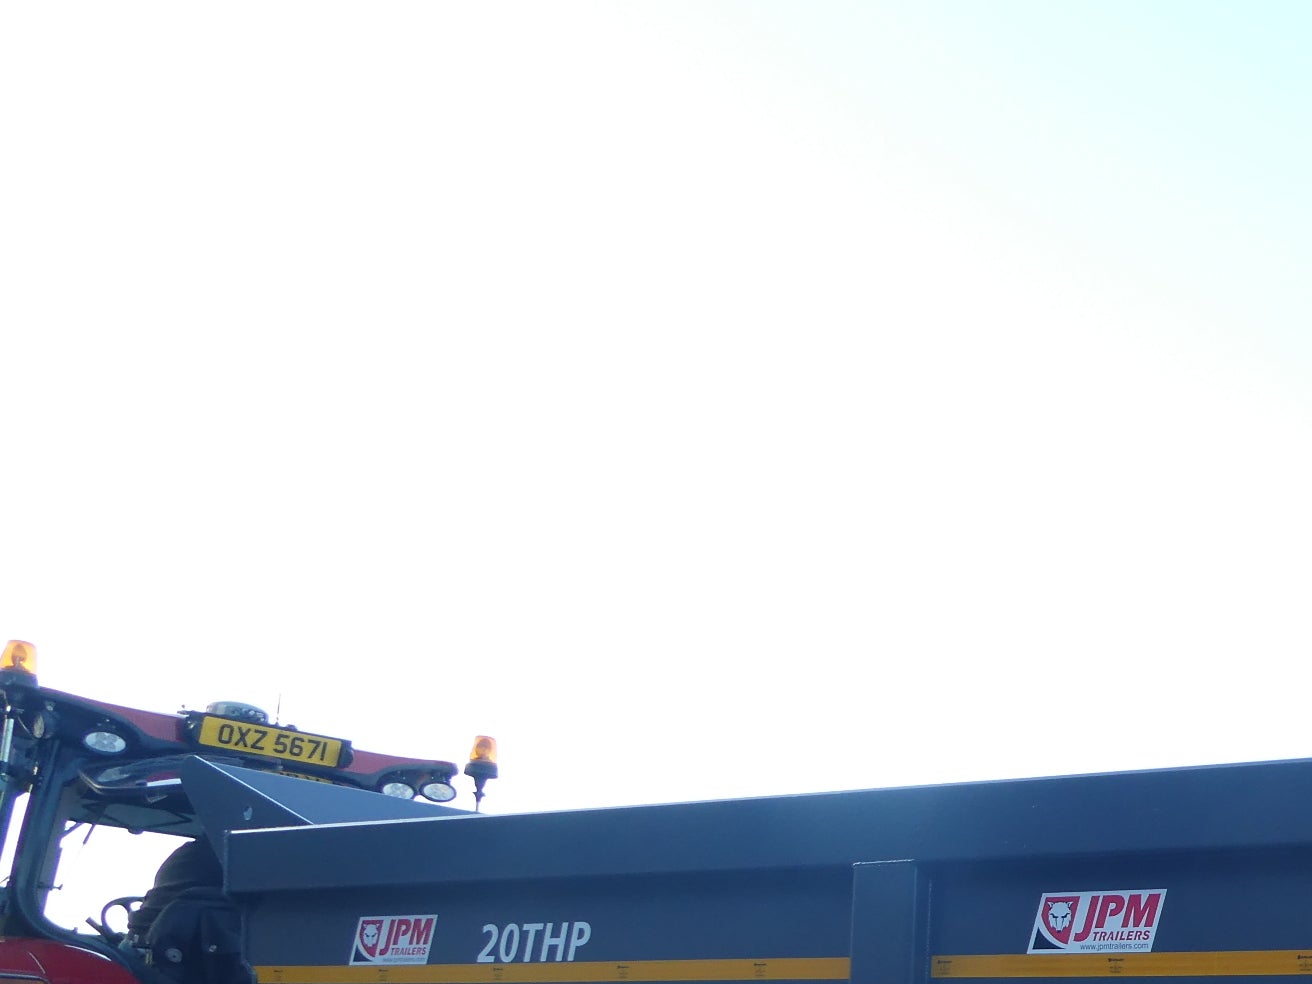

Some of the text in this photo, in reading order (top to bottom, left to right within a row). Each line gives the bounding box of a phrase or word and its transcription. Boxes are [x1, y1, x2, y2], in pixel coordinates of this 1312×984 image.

[217, 723, 329, 762] OXZ 5671
[379, 918, 434, 956] JPM
[1073, 893, 1162, 943] JPM
[1092, 930, 1151, 942] TRAILERS
[390, 946, 428, 957] TRAILERS
[475, 921, 592, 963] 20THP
[1079, 942, 1149, 952] www.jpmtrailers.com
